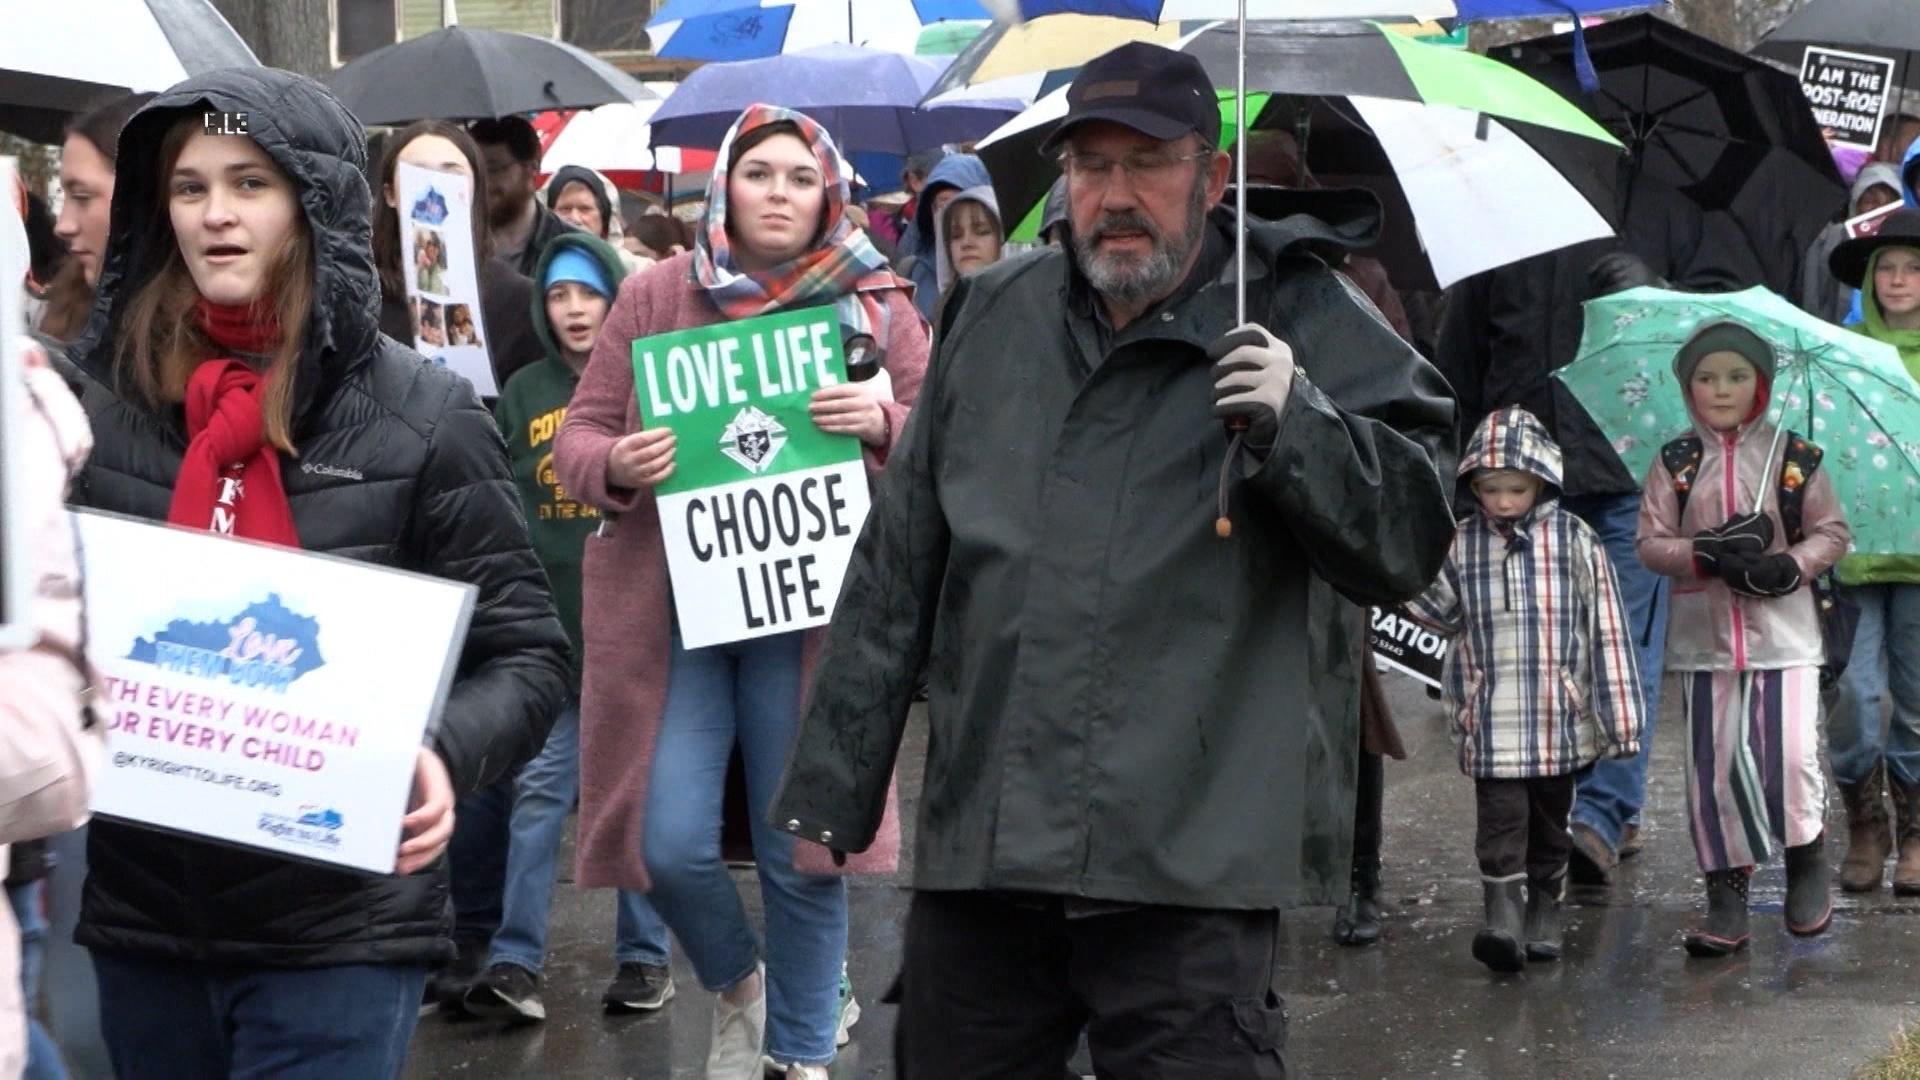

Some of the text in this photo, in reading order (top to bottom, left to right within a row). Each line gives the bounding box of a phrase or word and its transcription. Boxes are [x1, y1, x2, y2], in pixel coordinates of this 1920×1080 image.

[1802, 83, 1880, 113] POST-ROE
[1808, 64, 1815, 80] I
[1819, 67, 1845, 84] AM
[1850, 71, 1880, 91] THE
[643, 321, 838, 417] LOVE LIFE
[686, 473, 850, 562] CHOOSE
[737, 554, 825, 629] LIFE
[219, 617, 304, 666] Love
[147, 685, 235, 720] EVERY
[244, 704, 359, 747] WOMAN
[148, 717, 236, 753] EVERY
[241, 737, 327, 772] CHILD
